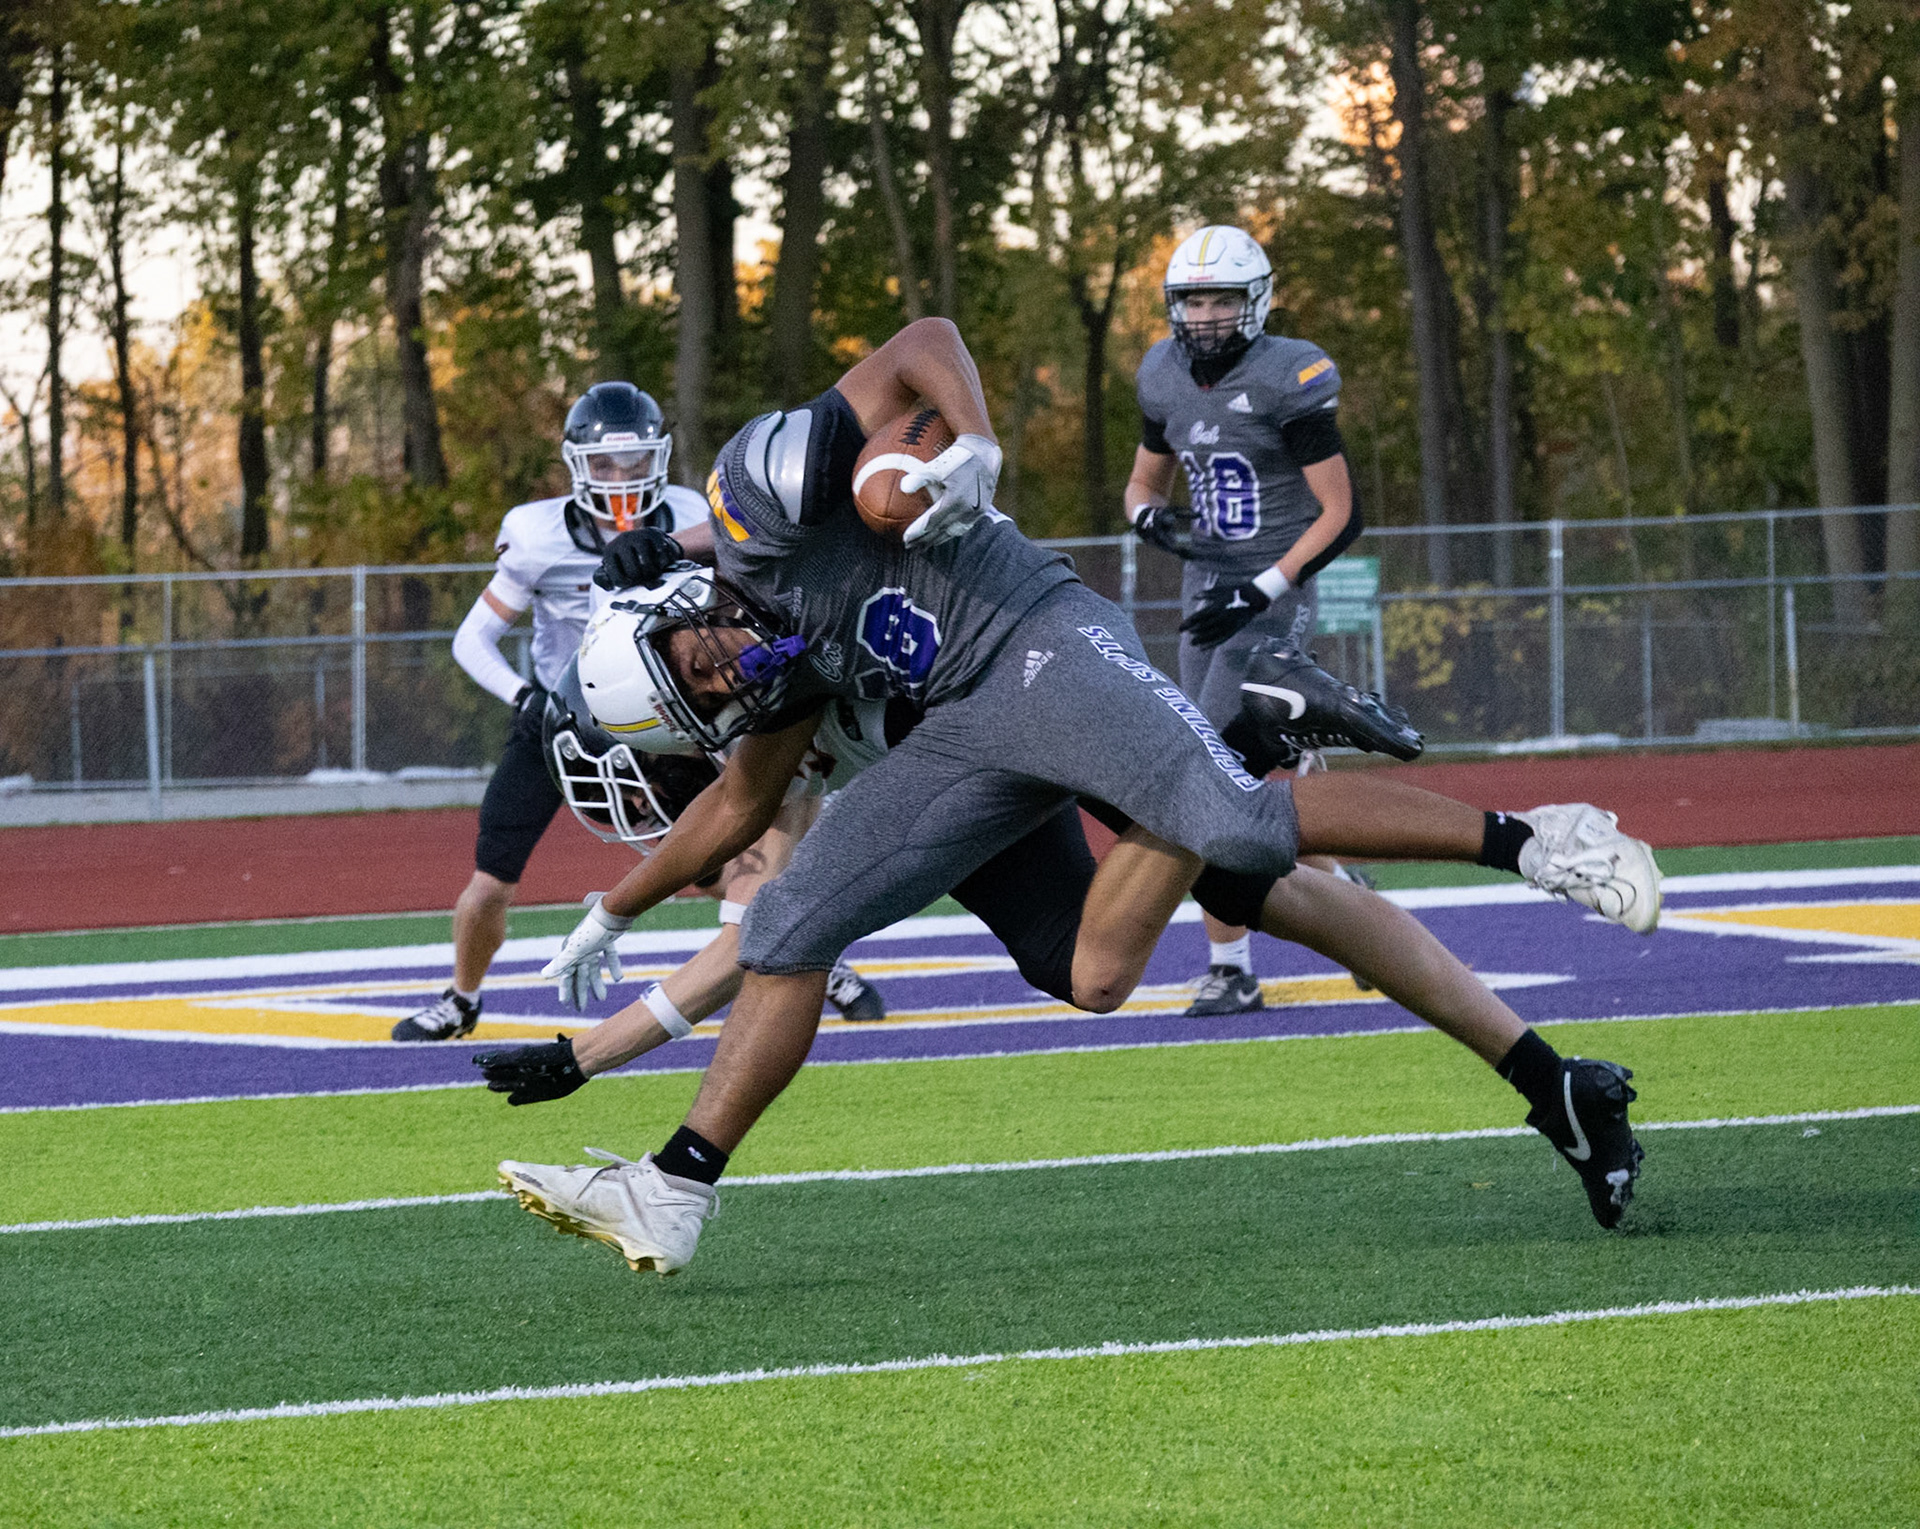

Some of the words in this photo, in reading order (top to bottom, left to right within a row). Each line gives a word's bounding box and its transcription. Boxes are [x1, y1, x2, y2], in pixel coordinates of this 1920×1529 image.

[1180, 450, 1261, 541] 18
[1023, 650, 1054, 687] adidas
[1077, 625, 1167, 682] SCOTS
[1152, 687, 1265, 792] FIGHTING
